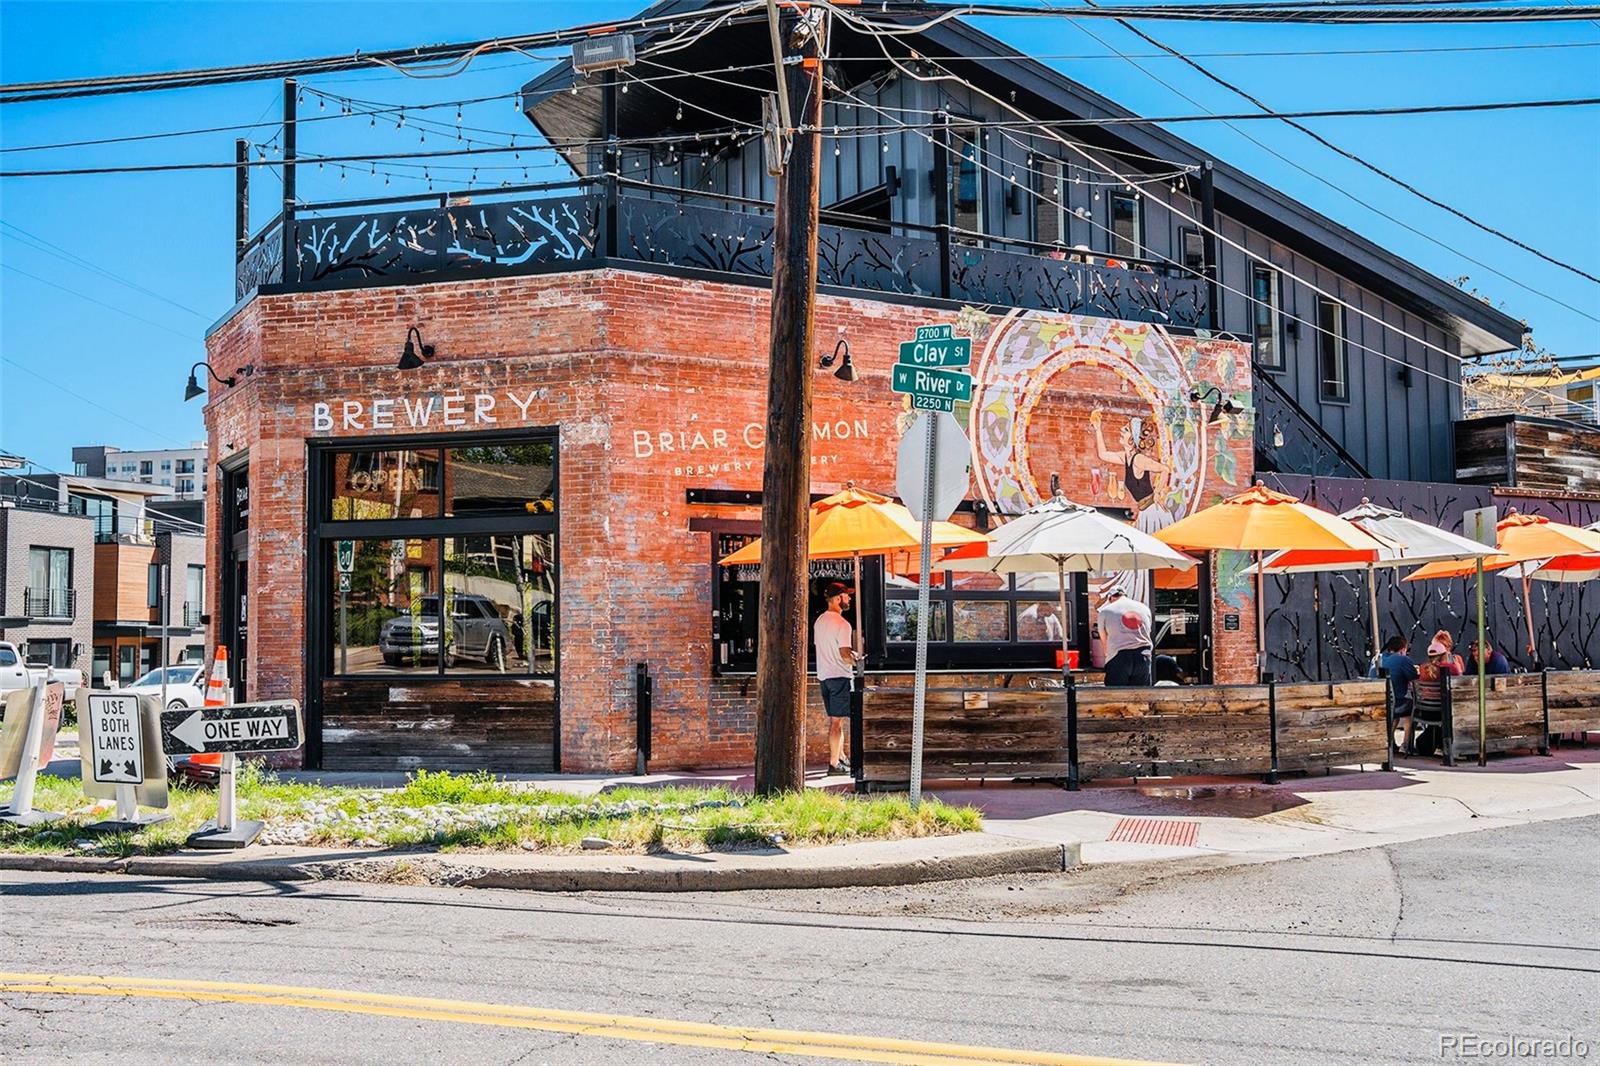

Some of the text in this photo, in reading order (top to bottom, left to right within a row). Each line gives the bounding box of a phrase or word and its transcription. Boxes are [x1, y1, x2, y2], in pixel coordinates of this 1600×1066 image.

[919, 327, 950, 339] 2700 W
[914, 343, 964, 365] Clay St
[899, 371, 964, 394] W River Dr
[314, 390, 538, 431] BREWERY
[917, 397, 951, 411] 2250 N
[633, 420, 869, 458] BRIAR CMON
[674, 461, 752, 476] BREWERY
[352, 468, 424, 493] OPEN
[102, 700, 125, 715] USE
[101, 718, 129, 732] BOTH
[204, 719, 282, 739] ONE WAY
[98, 736, 135, 751] LANES
